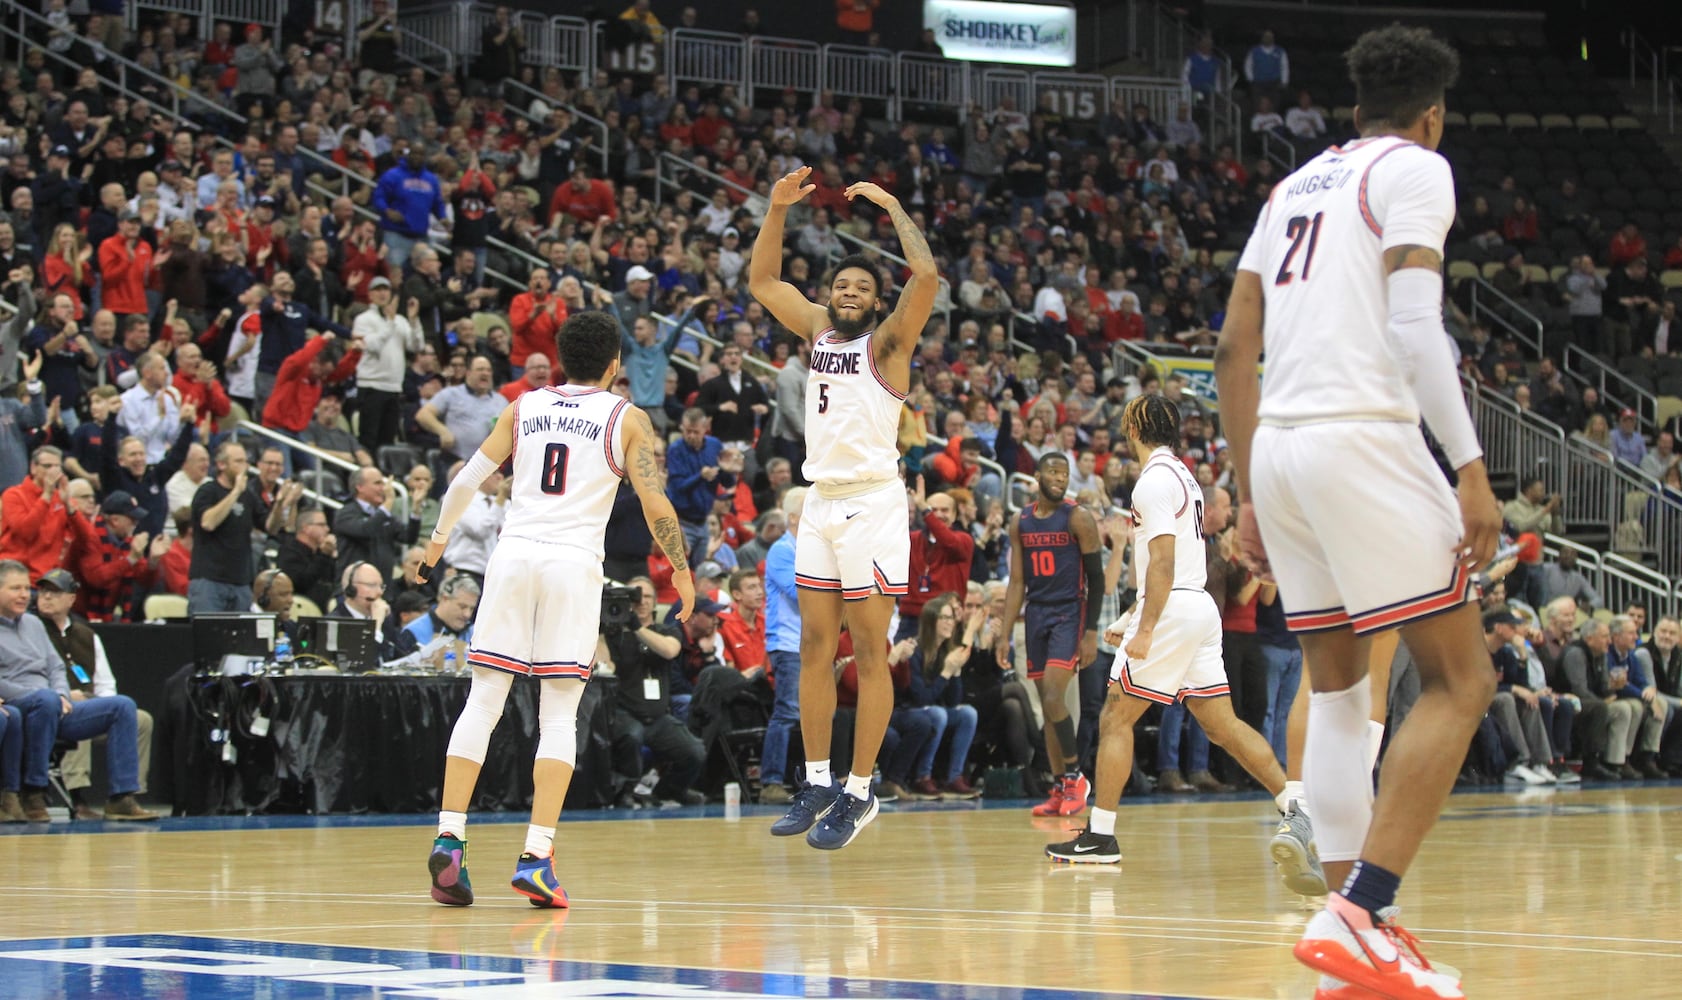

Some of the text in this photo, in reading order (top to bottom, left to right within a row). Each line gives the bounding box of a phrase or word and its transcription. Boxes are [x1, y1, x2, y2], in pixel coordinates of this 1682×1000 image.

[945, 18, 1041, 41] SHORKEY
[1275, 211, 1324, 286] 21
[818, 383, 829, 415] 5
[522, 415, 602, 442] DUNN-MARTIN
[541, 442, 570, 496] 0
[1022, 533, 1068, 546] LYERS
[1031, 550, 1056, 577] 10
